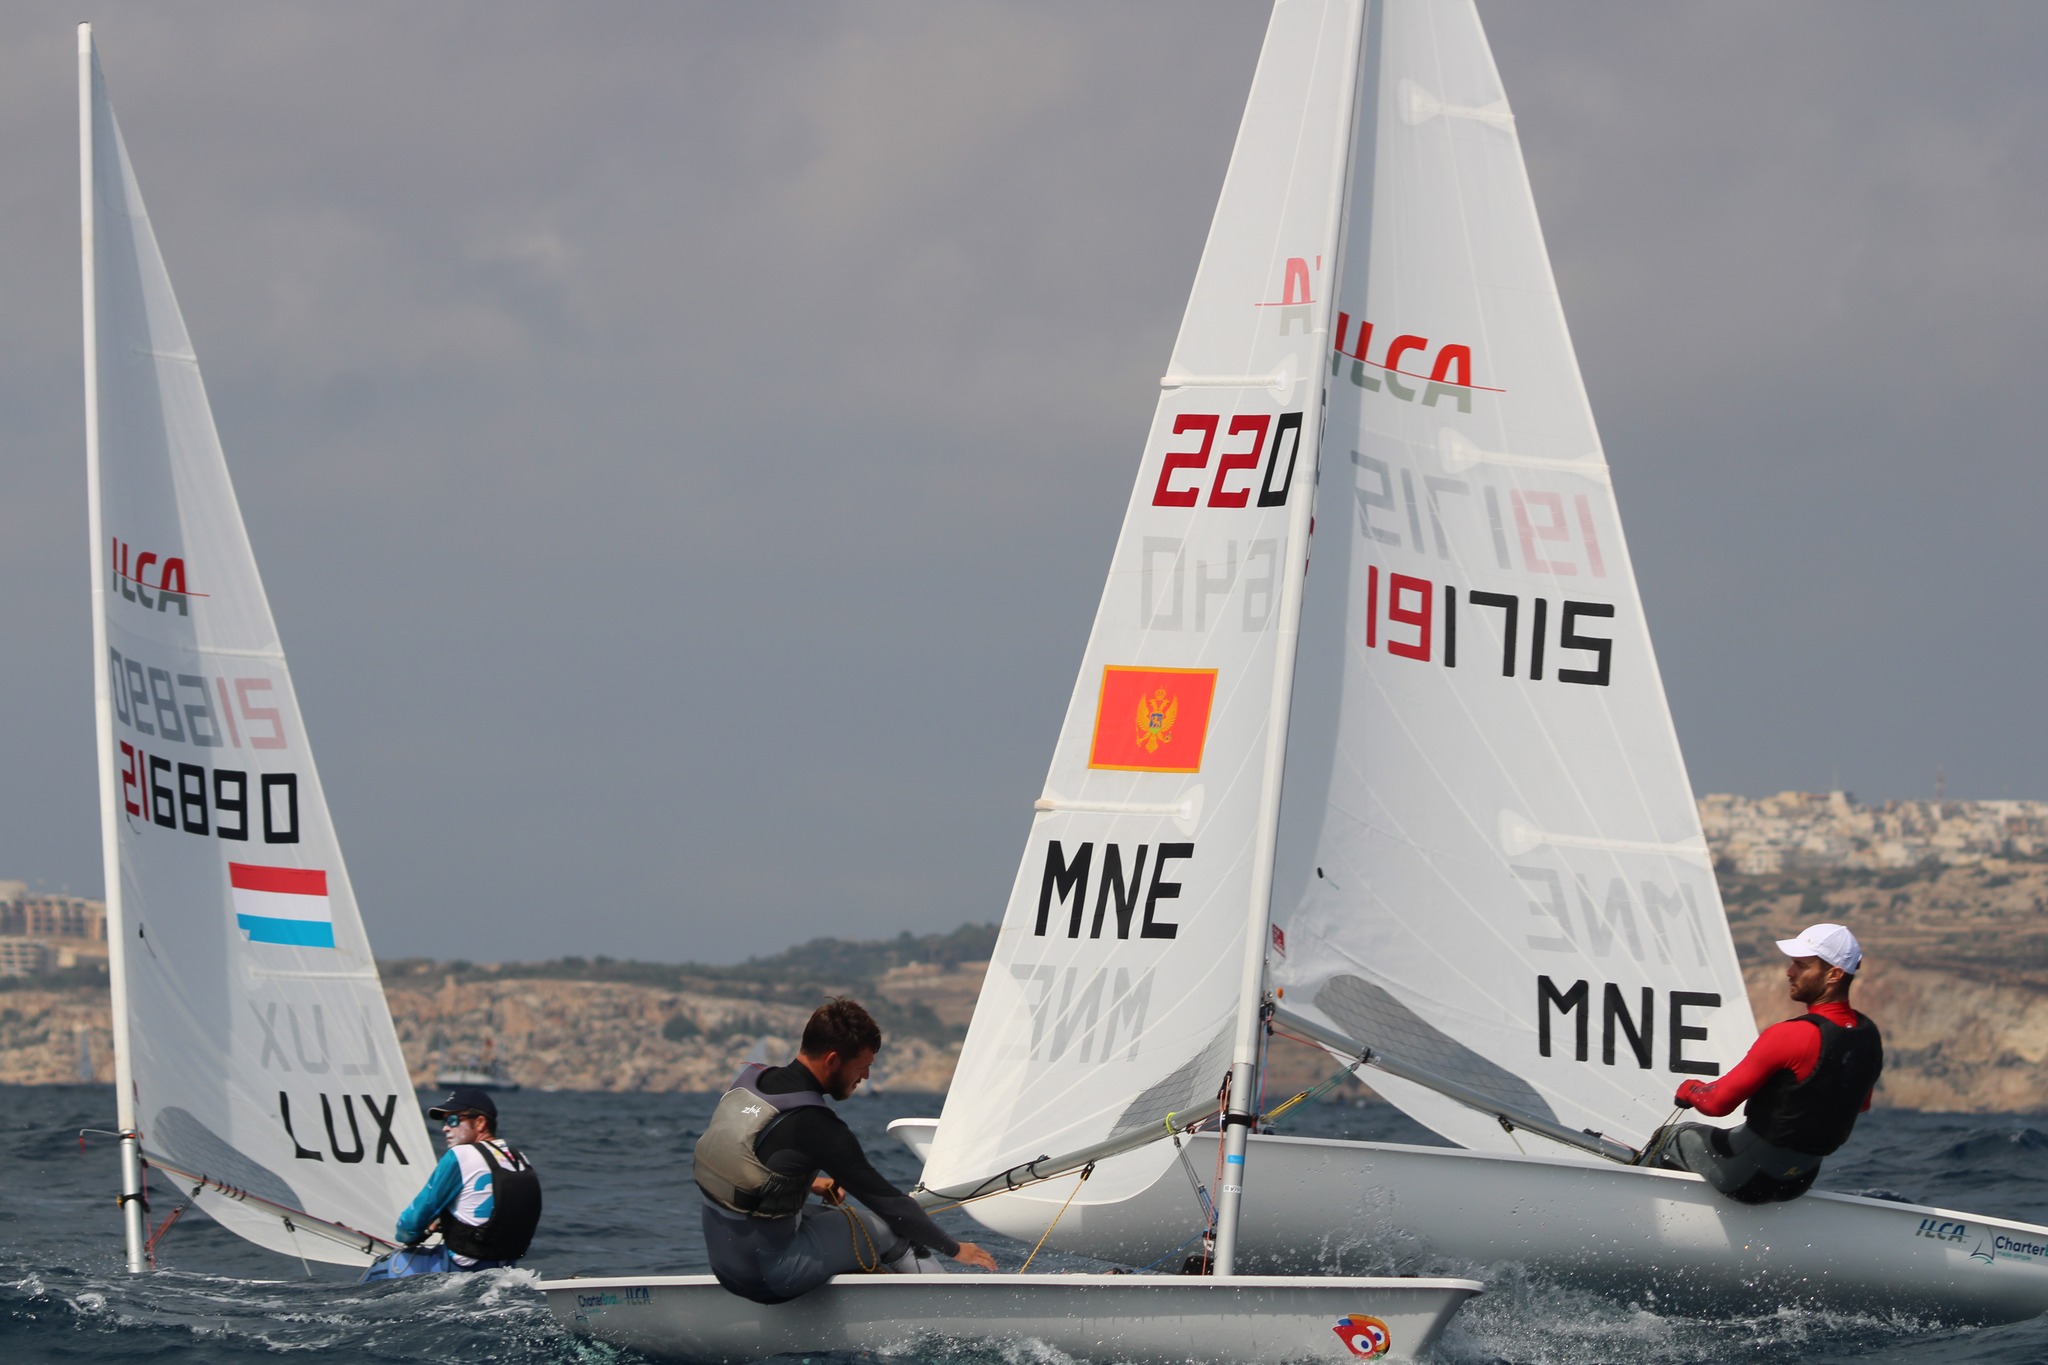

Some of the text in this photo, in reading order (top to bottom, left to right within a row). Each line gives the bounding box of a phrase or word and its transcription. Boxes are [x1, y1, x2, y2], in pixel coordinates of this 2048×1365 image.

[1332, 311, 1472, 414] ILCA
[1151, 411, 1304, 508] 220
[112, 536, 189, 617] ILCA
[1366, 564, 1615, 687] 191715
[119, 739, 300, 844] 216890
[1034, 839, 1195, 940] MNE
[1537, 974, 1722, 1077] MNE
[279, 1090, 410, 1166] LUX
[1915, 1218, 1968, 1244] ILCA
